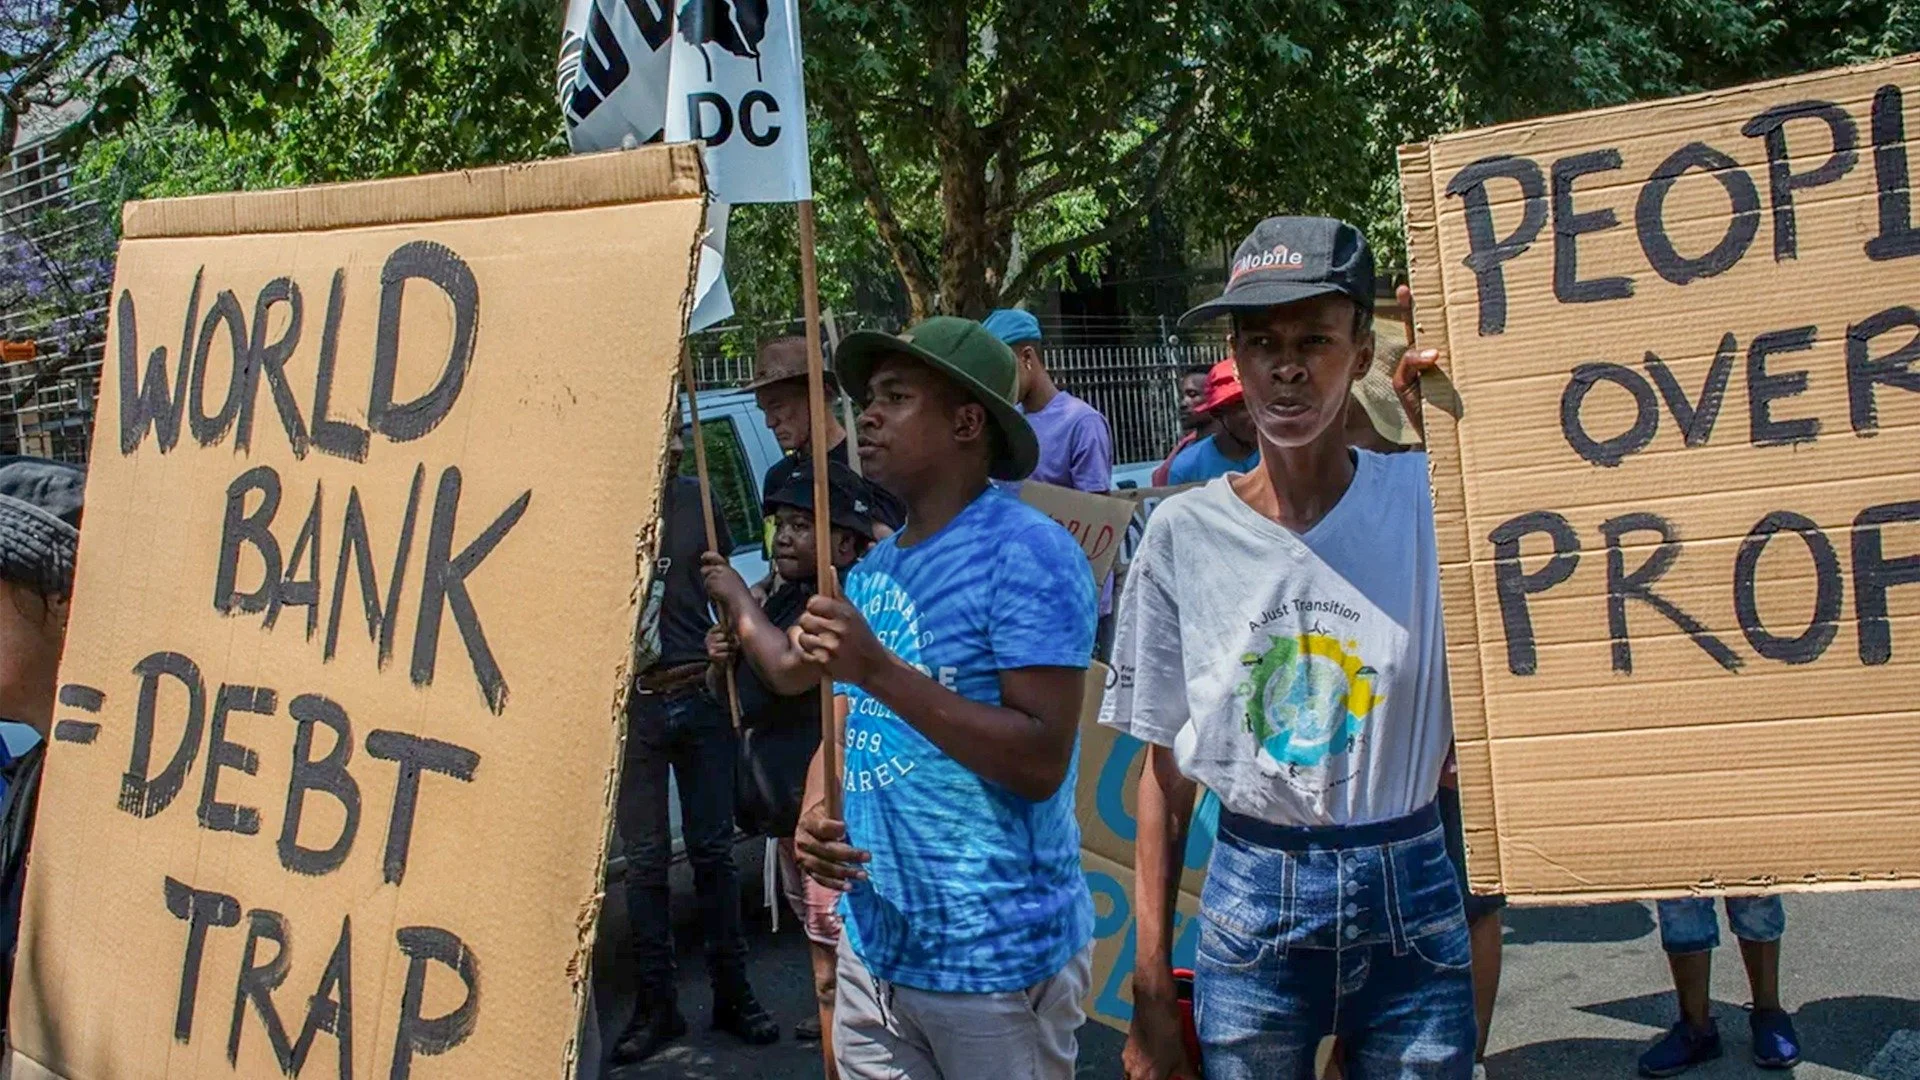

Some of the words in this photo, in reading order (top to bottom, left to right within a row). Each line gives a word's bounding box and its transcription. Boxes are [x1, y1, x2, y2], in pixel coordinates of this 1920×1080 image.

[687, 90, 781, 147] DC
[1446, 84, 1920, 336] PEOPL
[118, 240, 480, 464] WORLD
[1560, 306, 1920, 467] OVER
[214, 464, 532, 715] BANK
[1249, 620, 1260, 632] A
[1261, 604, 1289, 624] Just
[1291, 598, 1361, 622] Transition
[1488, 502, 1920, 677] PROF
[117, 651, 482, 885] DEBT
[163, 875, 482, 1080] TRAP
